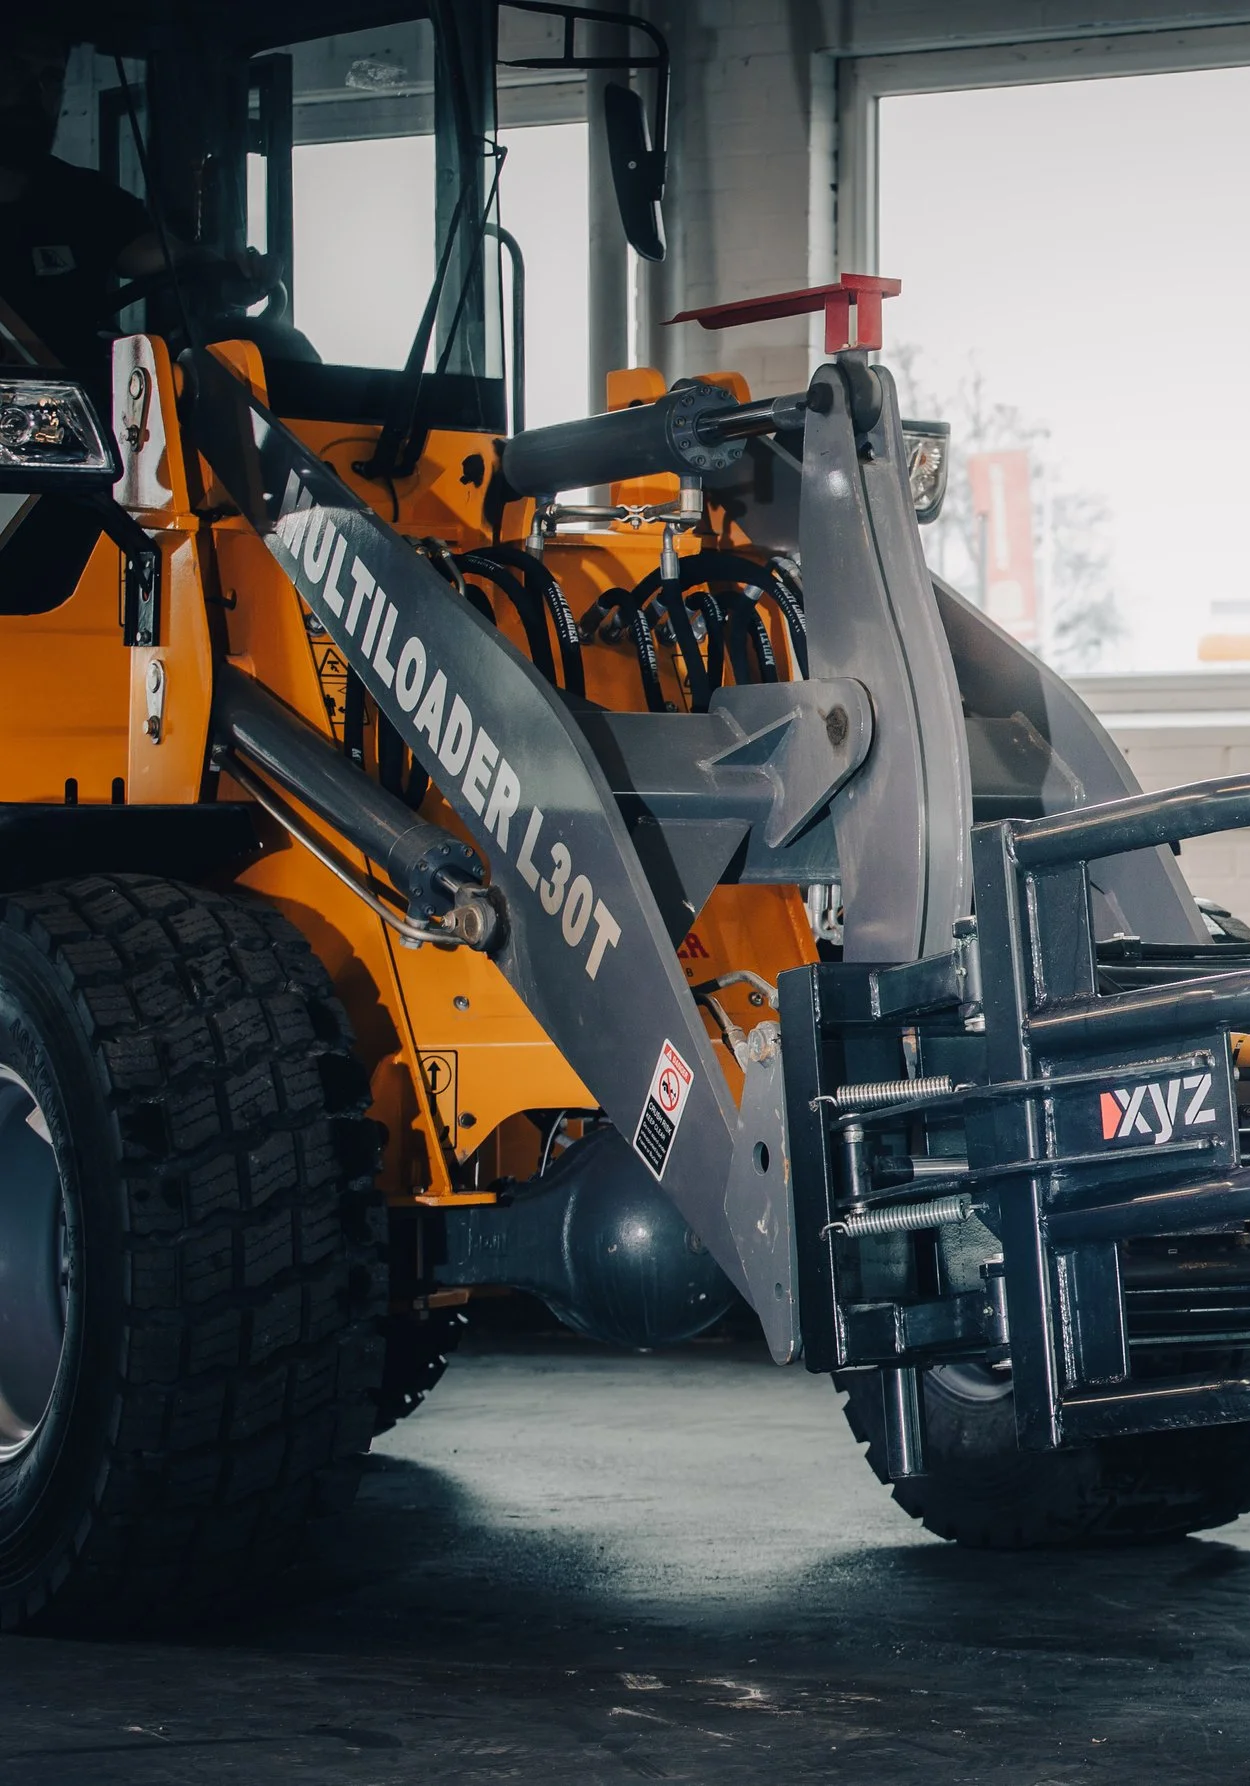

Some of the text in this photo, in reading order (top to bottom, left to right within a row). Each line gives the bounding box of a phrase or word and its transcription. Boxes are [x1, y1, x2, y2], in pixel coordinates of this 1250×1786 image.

[276, 467, 623, 982] MULTILOADER L30T
[645, 1112, 667, 1141] KEEP CLEAR
[648, 1101, 673, 1136] CRUSH RISK
[1110, 1072, 1217, 1146] xyz
